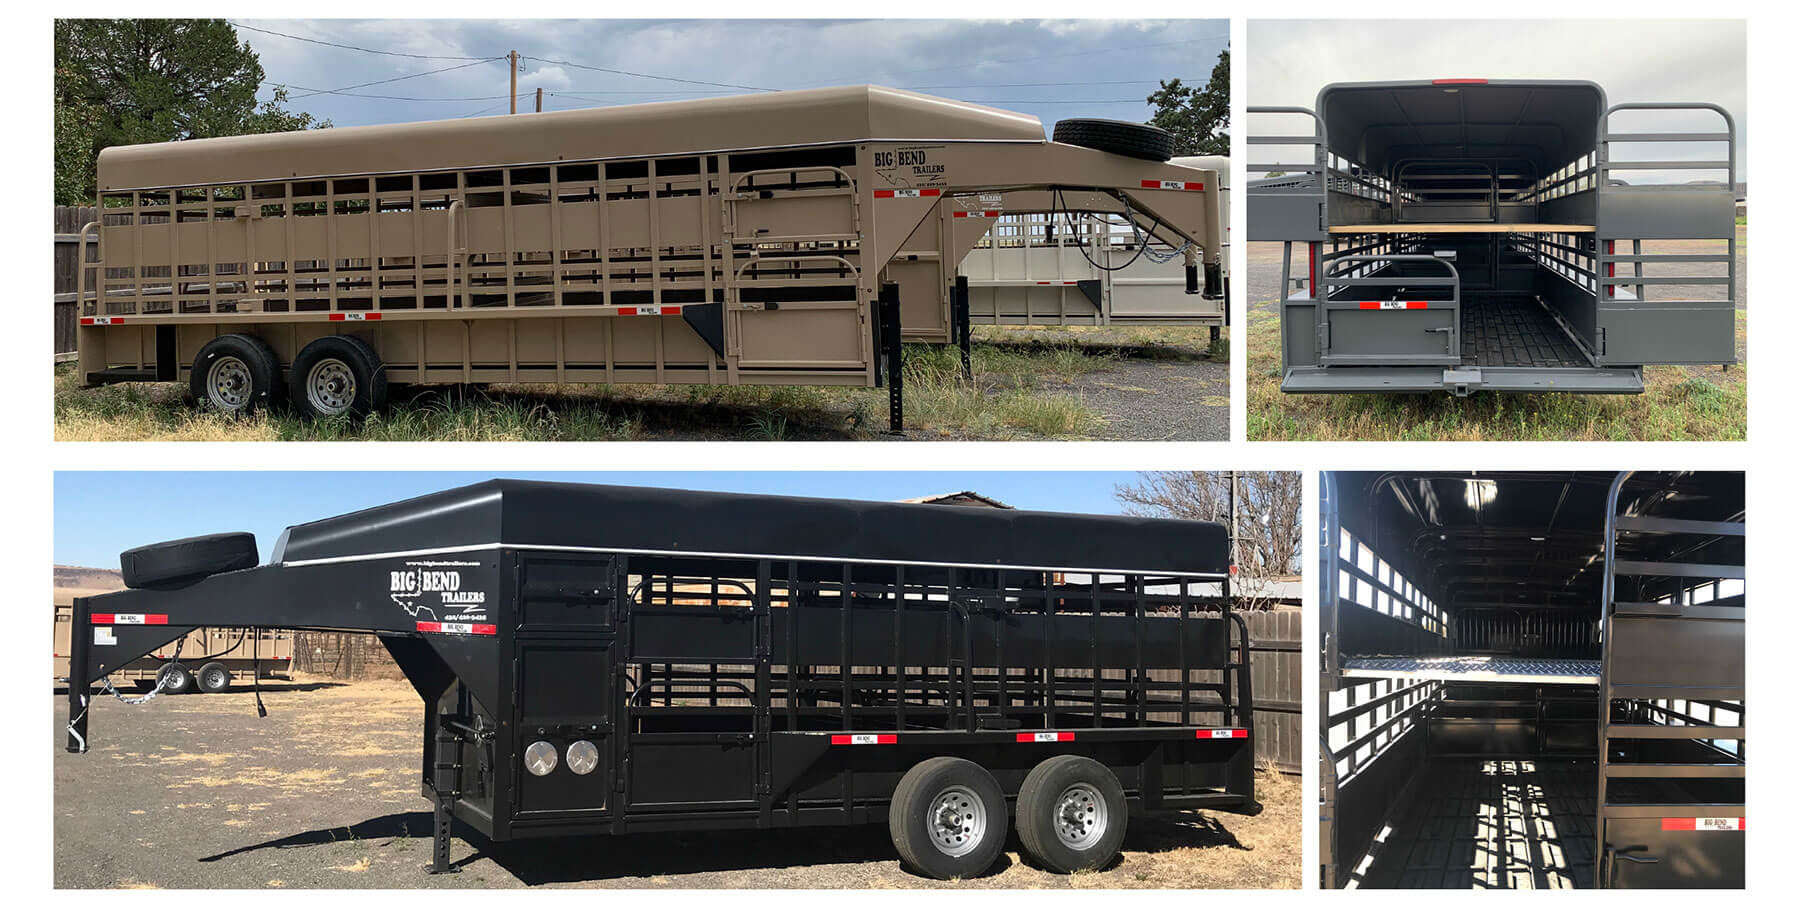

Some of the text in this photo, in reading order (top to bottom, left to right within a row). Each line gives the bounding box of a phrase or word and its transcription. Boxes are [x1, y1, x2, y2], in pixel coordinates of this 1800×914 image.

[874, 150, 926, 167] BIG BEND
[912, 165, 945, 174] TRAILERS
[390, 571, 460, 591] BIG BEND
[441, 592, 485, 603] TRAILERS
